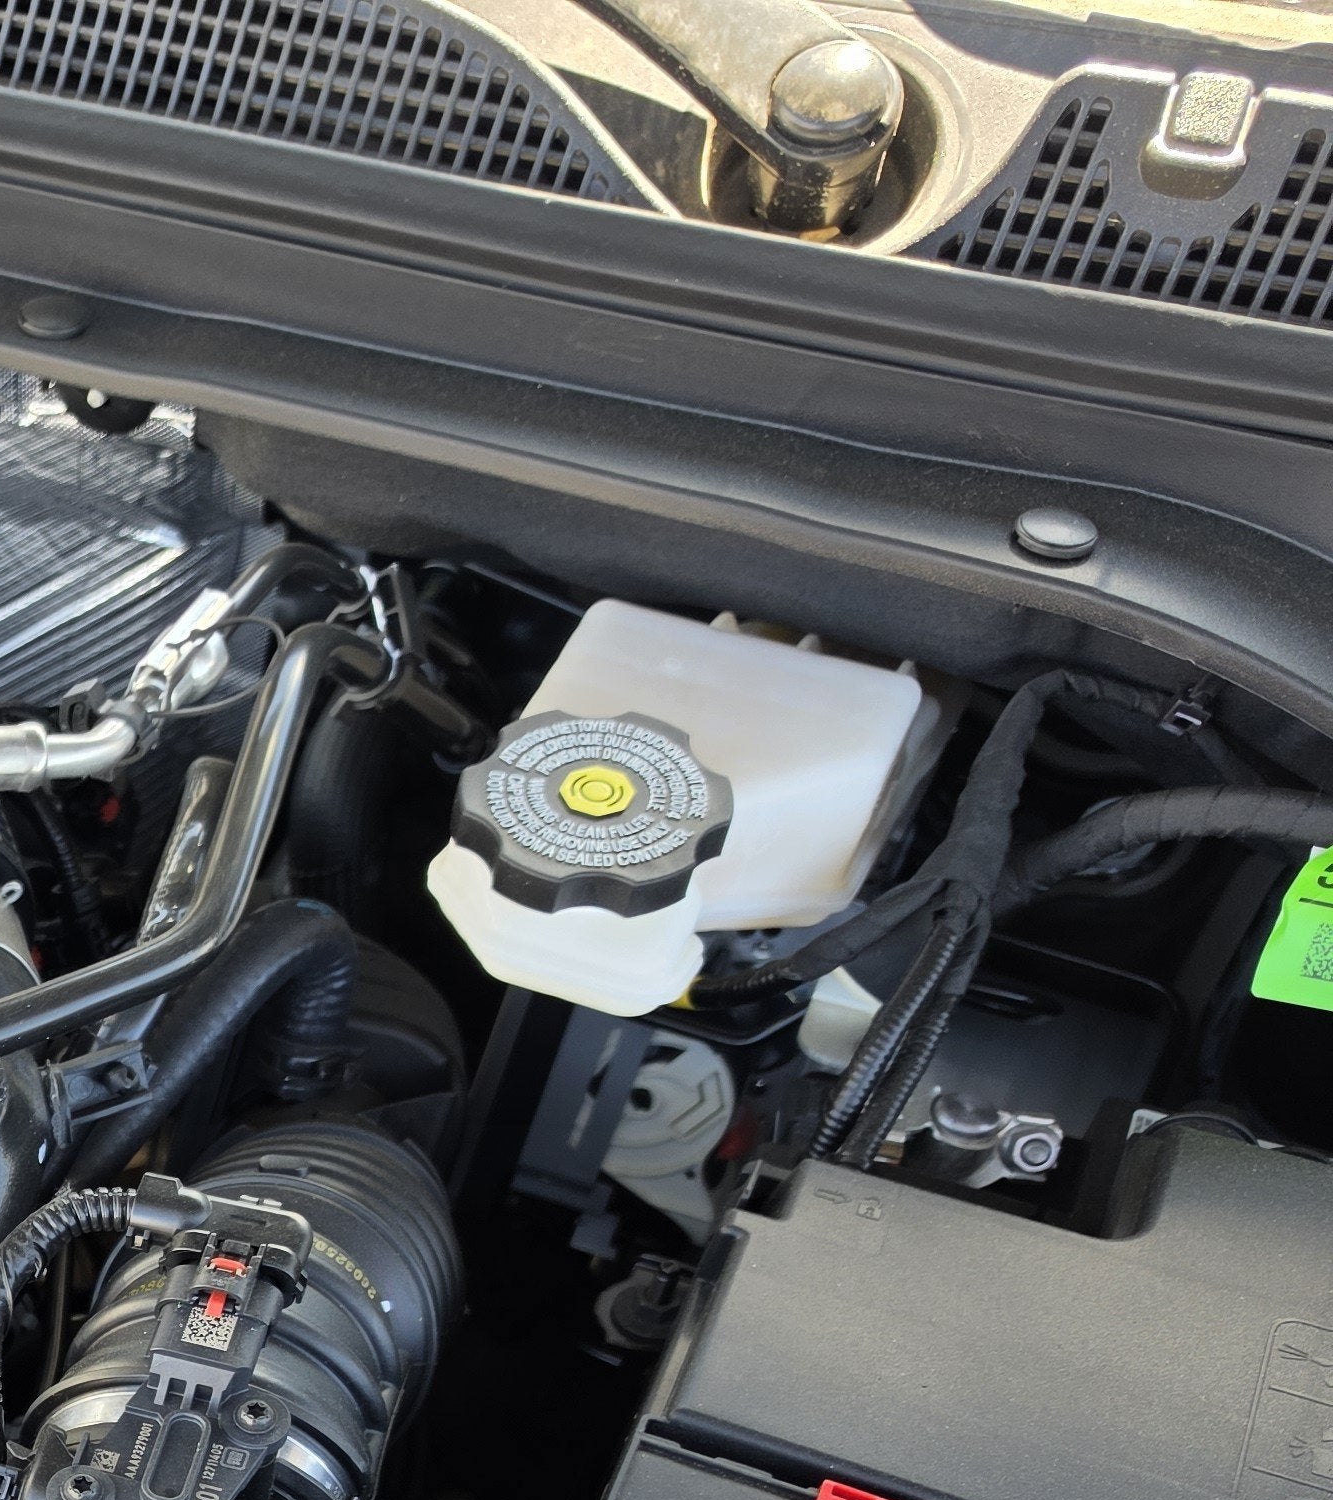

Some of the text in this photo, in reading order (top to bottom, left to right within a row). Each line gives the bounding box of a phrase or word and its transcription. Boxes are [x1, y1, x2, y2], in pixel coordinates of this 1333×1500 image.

[603, 734, 621, 747] DU
[617, 722, 635, 738] LE
[507, 773, 525, 796] CAP
[508, 795, 545, 833] BEFORE
[488, 799, 516, 828] FLUID
[507, 824, 548, 853] FROM
[541, 844, 556, 858] A
[555, 848, 616, 867] SEALED
[558, 820, 607, 839] CLEAN
[608, 813, 656, 839] FILLER
[638, 820, 672, 844] ONLY
[612, 836, 642, 853] USE
